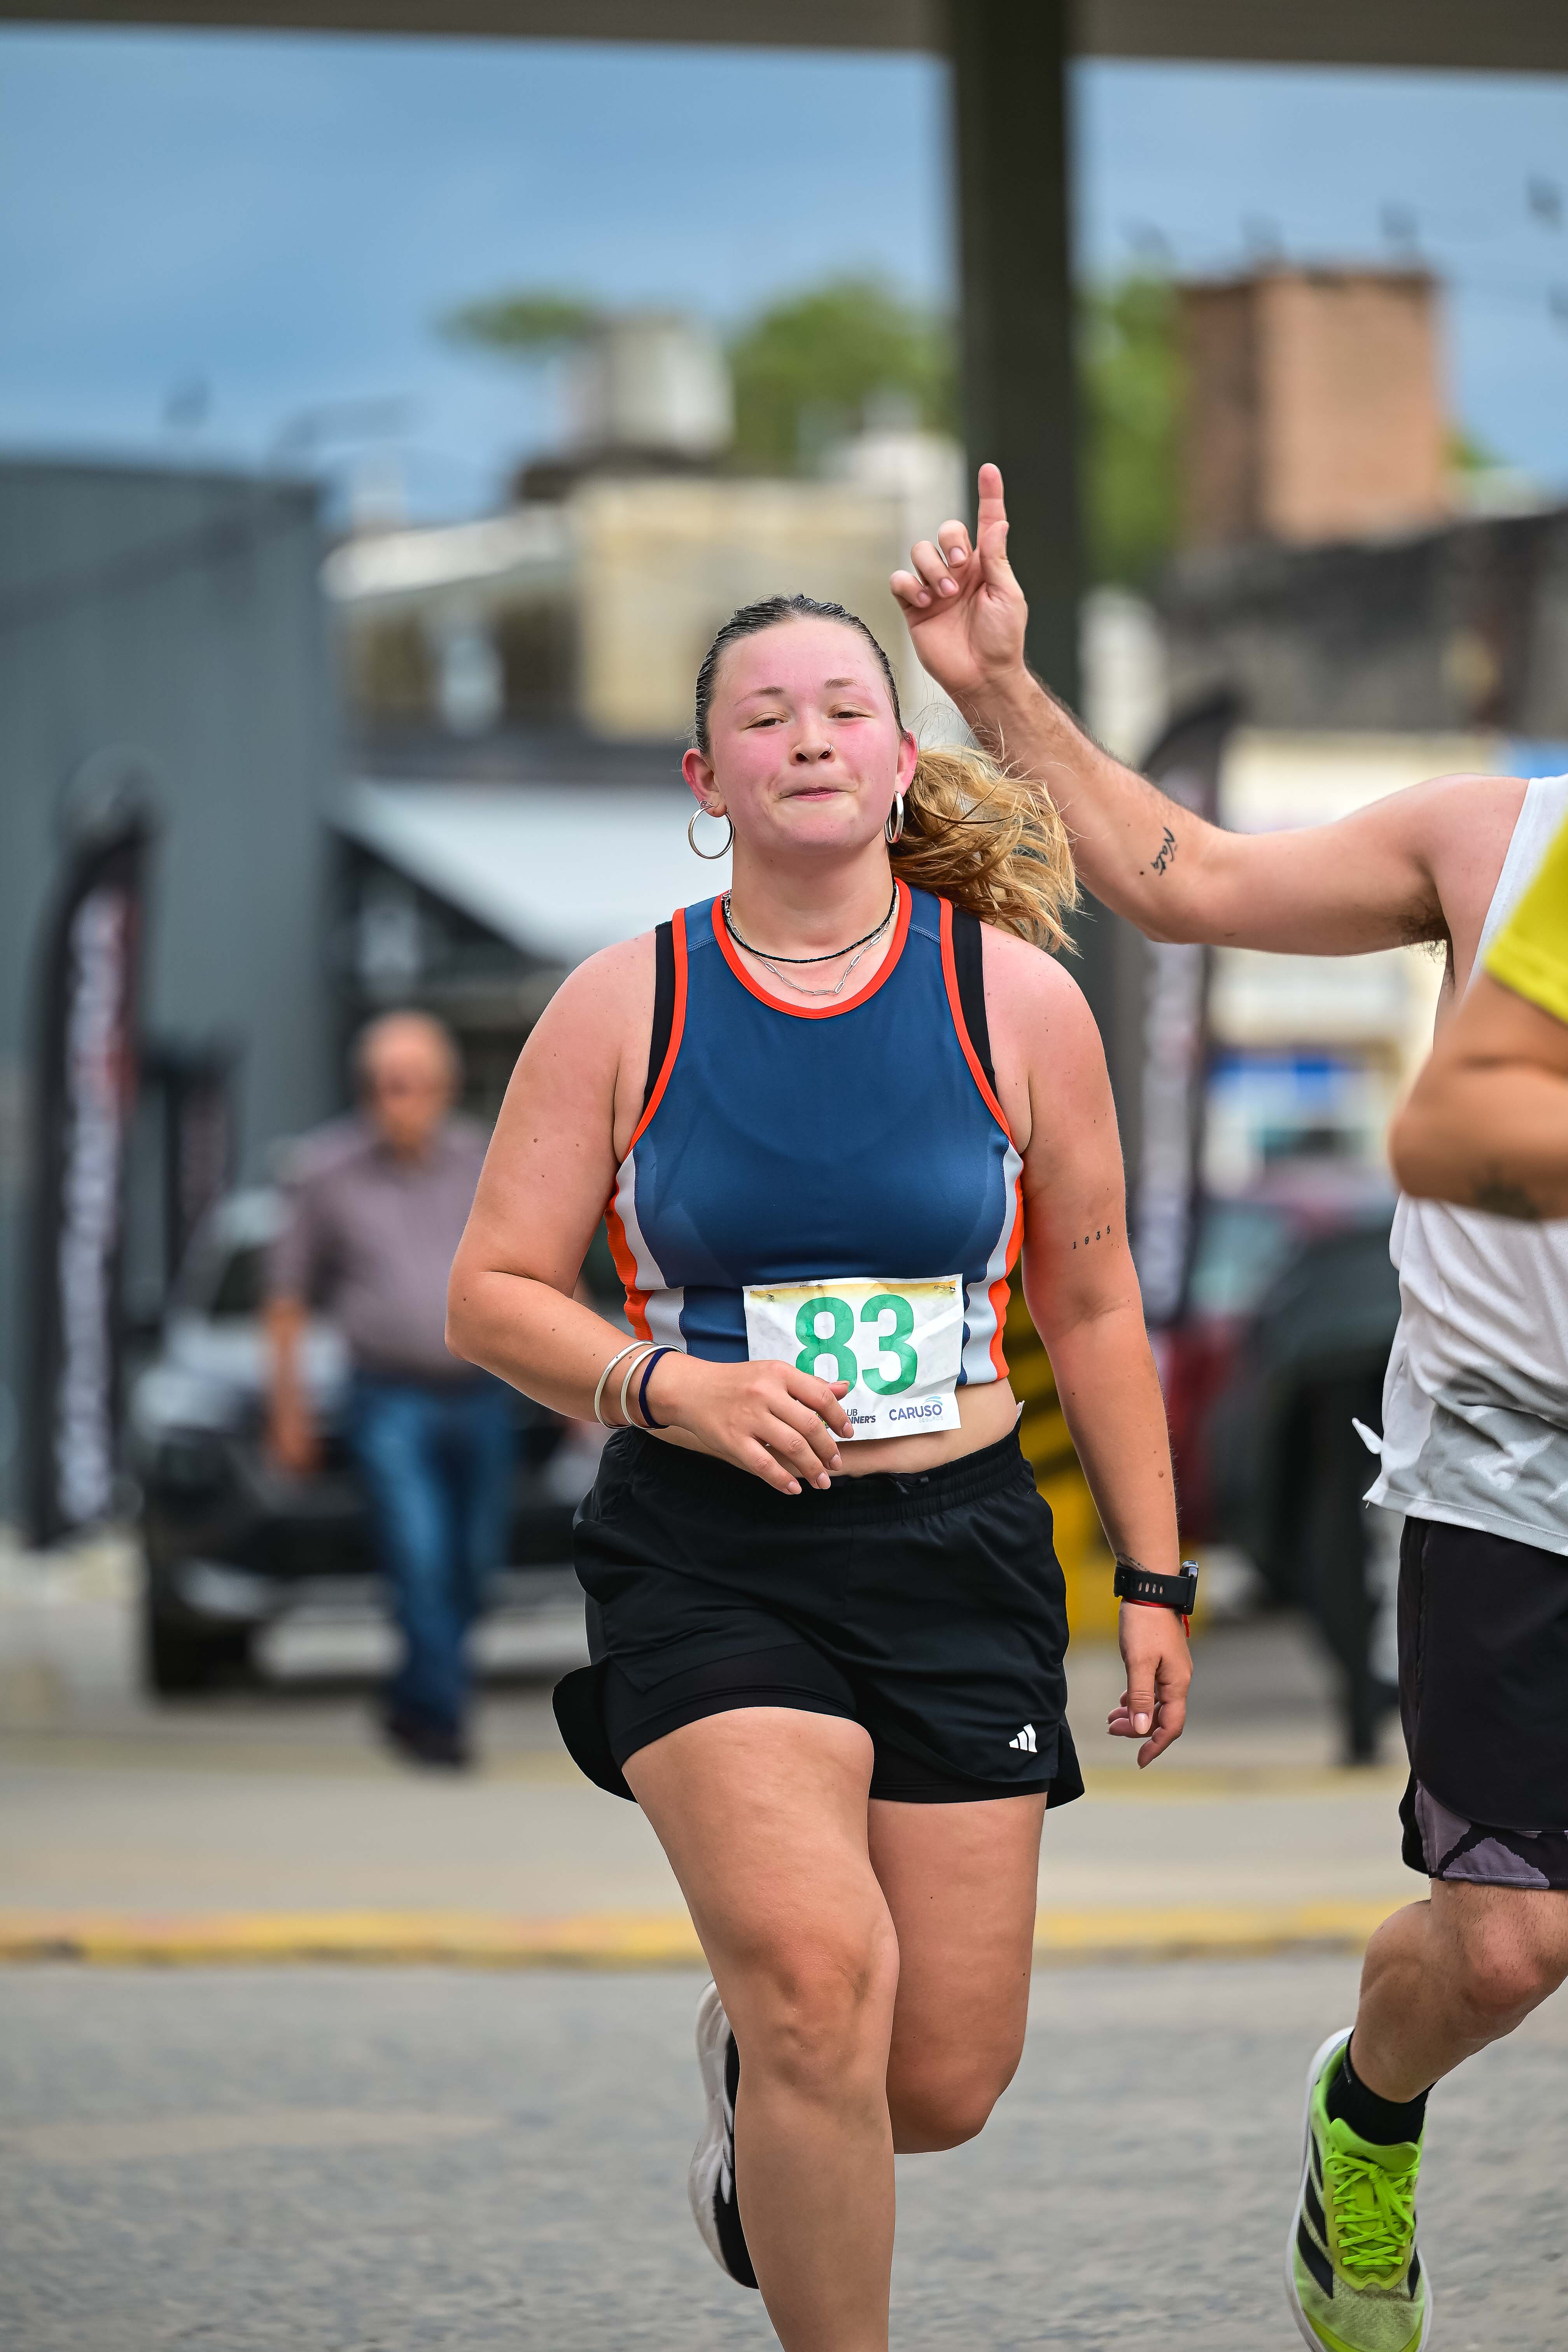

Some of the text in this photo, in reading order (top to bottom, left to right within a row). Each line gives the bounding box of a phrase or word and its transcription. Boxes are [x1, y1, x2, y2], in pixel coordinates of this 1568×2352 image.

[796, 1294, 917, 1395] 83
[848, 1415, 876, 1424] NNER'S
[889, 1404, 942, 1421] CARUSO
